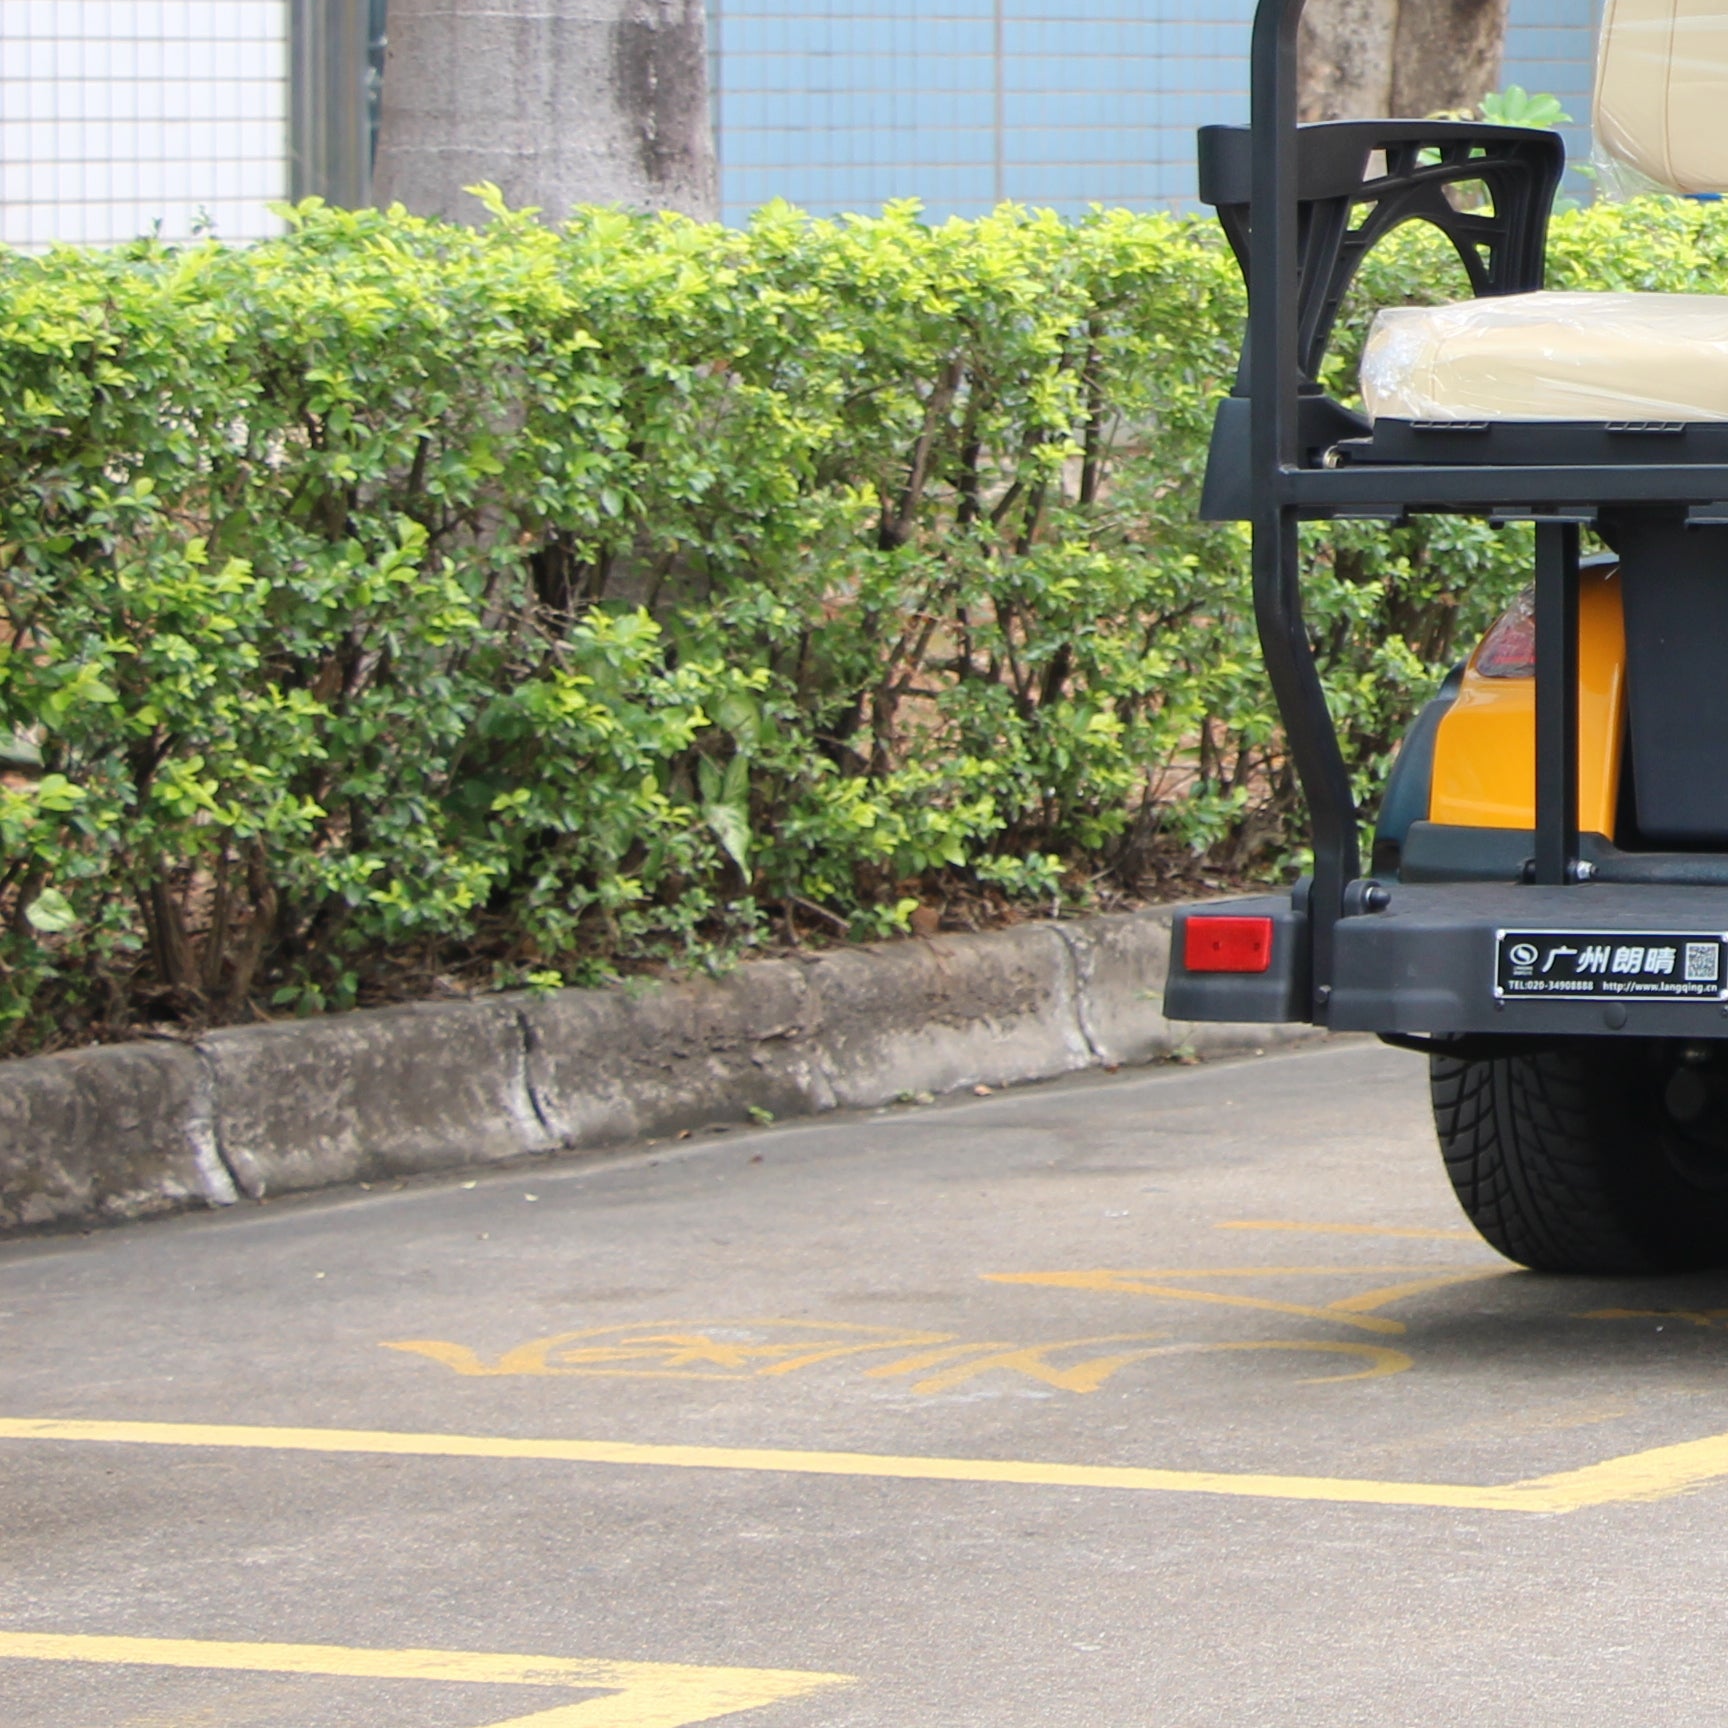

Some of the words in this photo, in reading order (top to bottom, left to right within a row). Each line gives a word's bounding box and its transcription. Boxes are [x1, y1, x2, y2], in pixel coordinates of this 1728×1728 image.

[1541, 945, 1677, 975] 广州朗晴
[1602, 981, 1718, 994] http://www.langqing.cn
